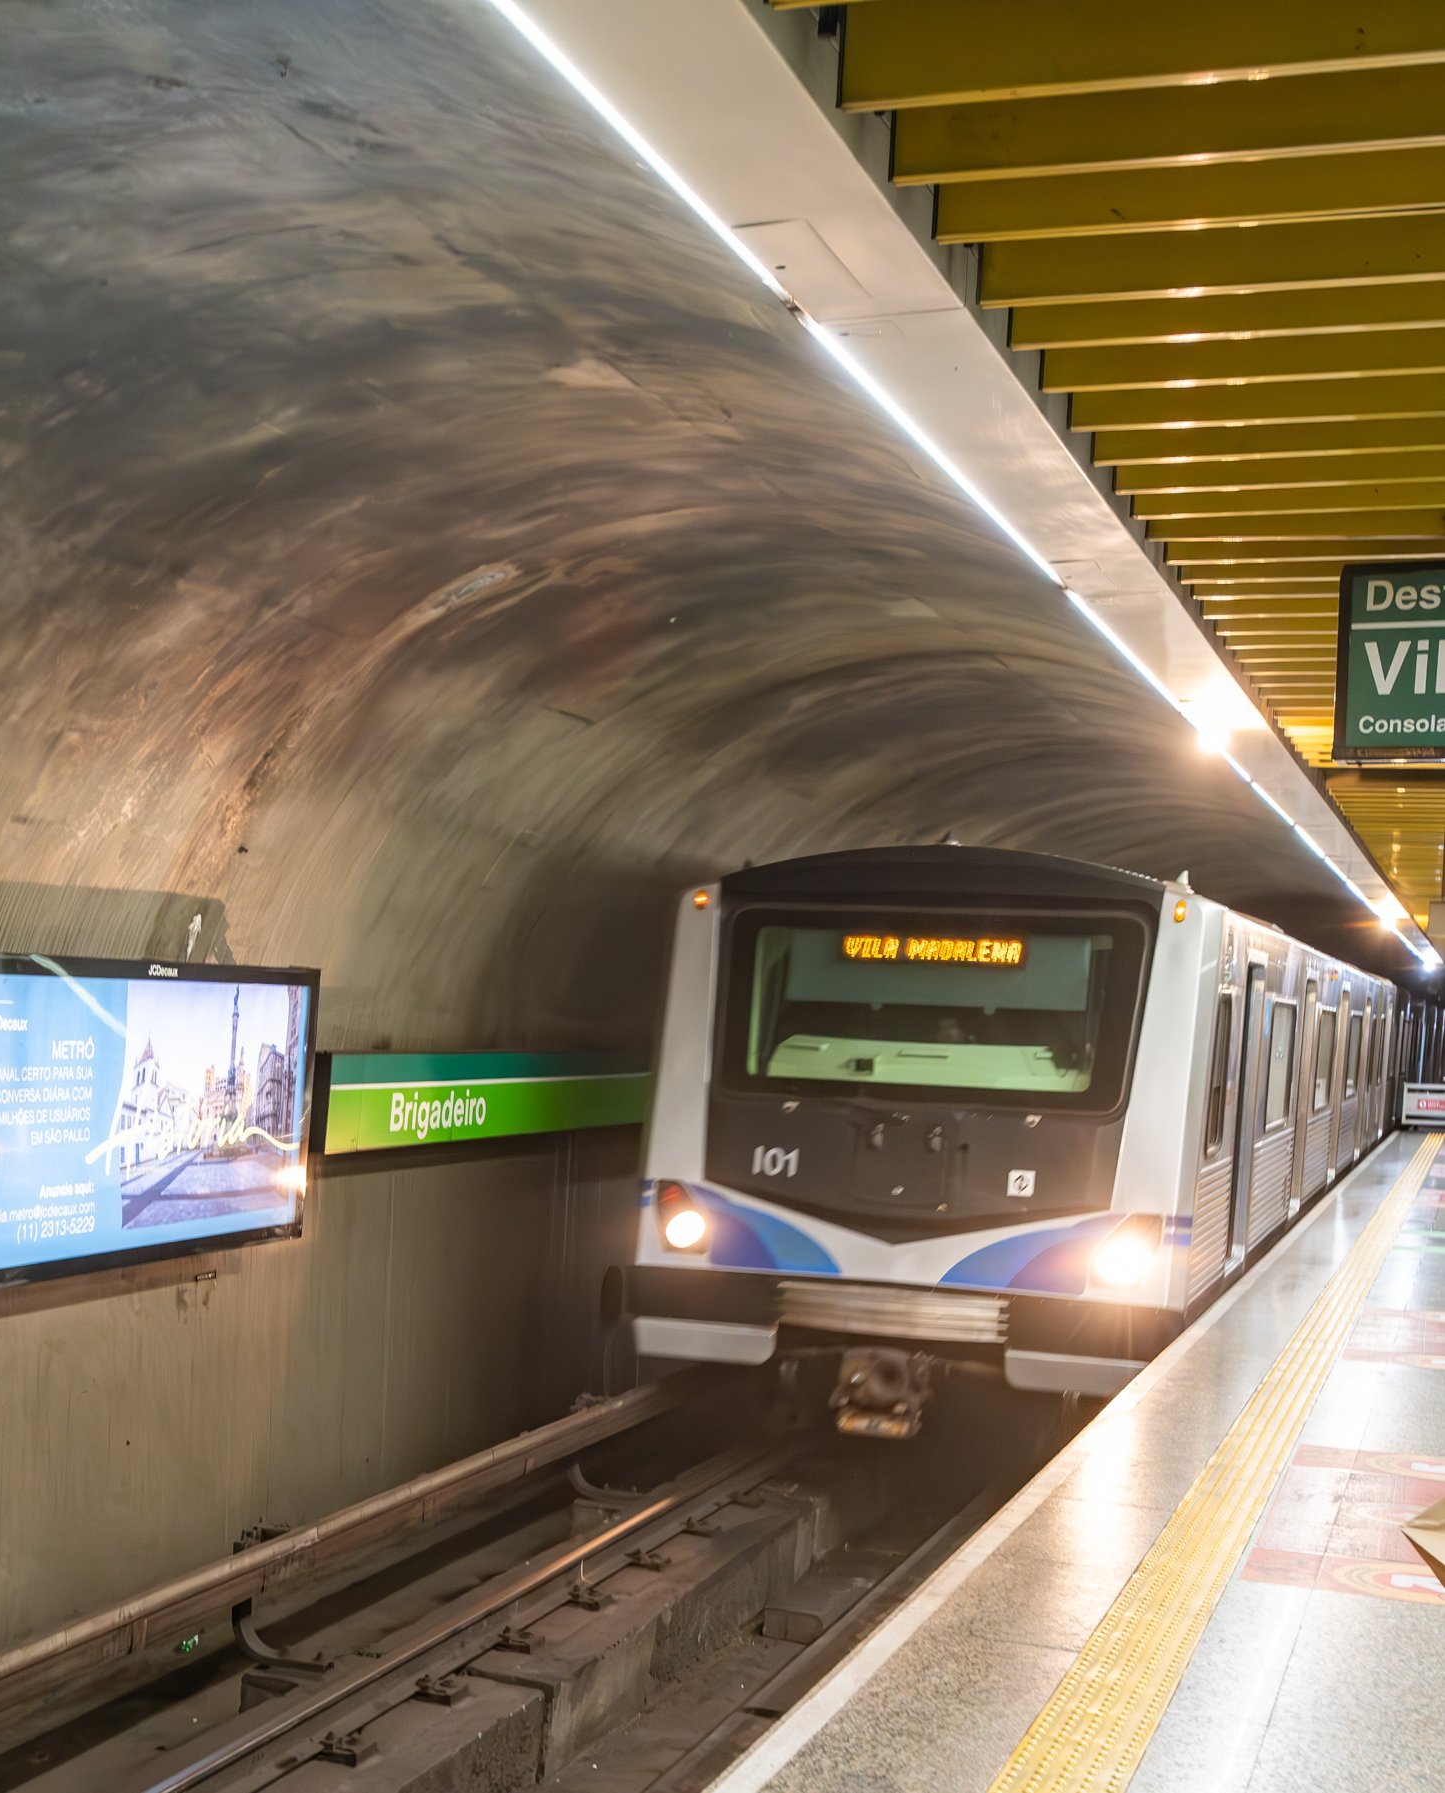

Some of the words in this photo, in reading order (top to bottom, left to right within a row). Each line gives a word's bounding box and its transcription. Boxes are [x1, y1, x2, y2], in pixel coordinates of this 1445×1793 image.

[1366, 578, 1445, 612] Des
[845, 936, 900, 959] VILA
[906, 938, 1023, 964] MADALENA
[52, 1035, 95, 1060] METRÔ
[21, 1066, 51, 1081] CERTO
[53, 1066, 74, 1080] PARA
[76, 1065, 94, 1080] SUA
[43, 1084, 70, 1102] DIÁRIA
[72, 1086, 92, 1101] COM
[36, 1109, 48, 1124] DE
[50, 1106, 91, 1123] USUÁRIOS
[389, 1088, 487, 1140] Brigadeiro
[31, 1130, 44, 1146] EM
[44, 1127, 62, 1145] SÃO
[63, 1127, 91, 1143] PAULO
[751, 1145, 800, 1178] 101
[17, 1222, 38, 1245] (11)
[41, 1215, 95, 1239] 2313-5229
